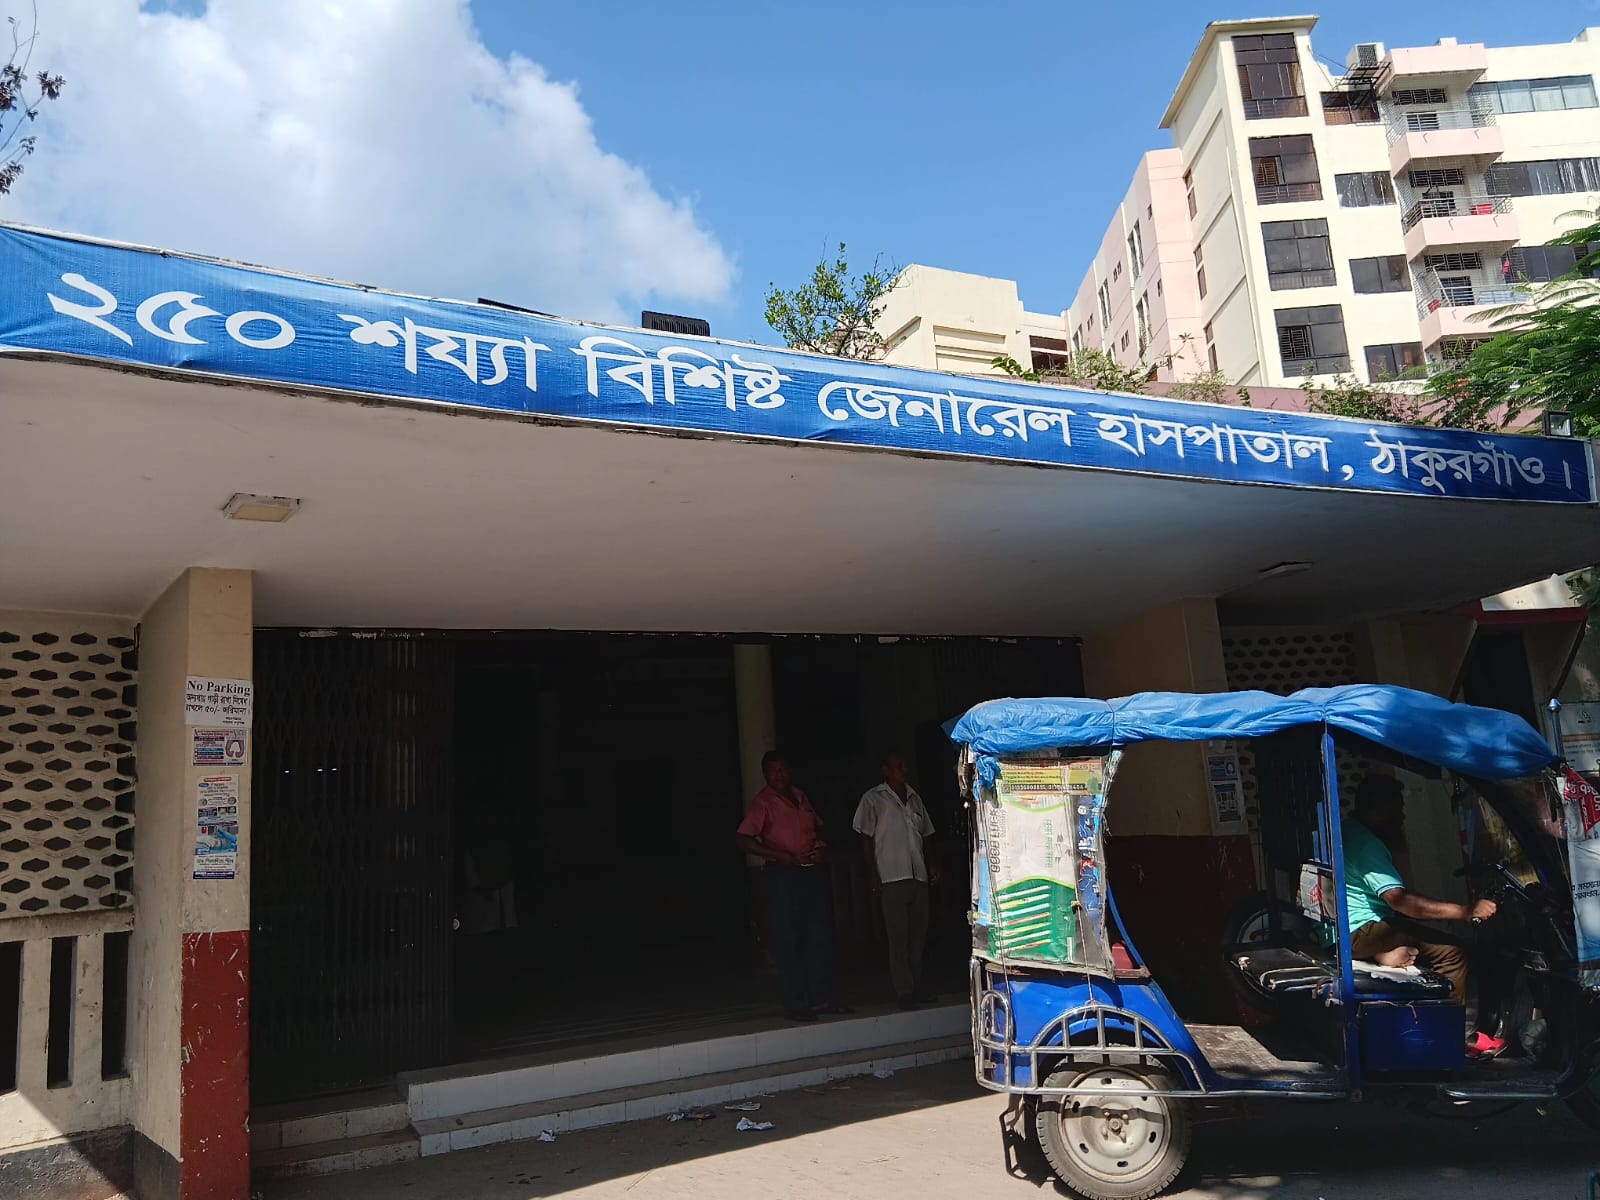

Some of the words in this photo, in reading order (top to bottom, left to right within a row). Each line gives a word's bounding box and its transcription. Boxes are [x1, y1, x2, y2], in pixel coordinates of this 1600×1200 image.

[46, 271, 296, 351] ২৫০
[336, 313, 551, 392] শয্যা
[570, 336, 791, 412] বিশিষ্ট
[818, 379, 1076, 447] জেনারেল
[187, 680, 203, 691] No
[206, 681, 251, 695] Parking
